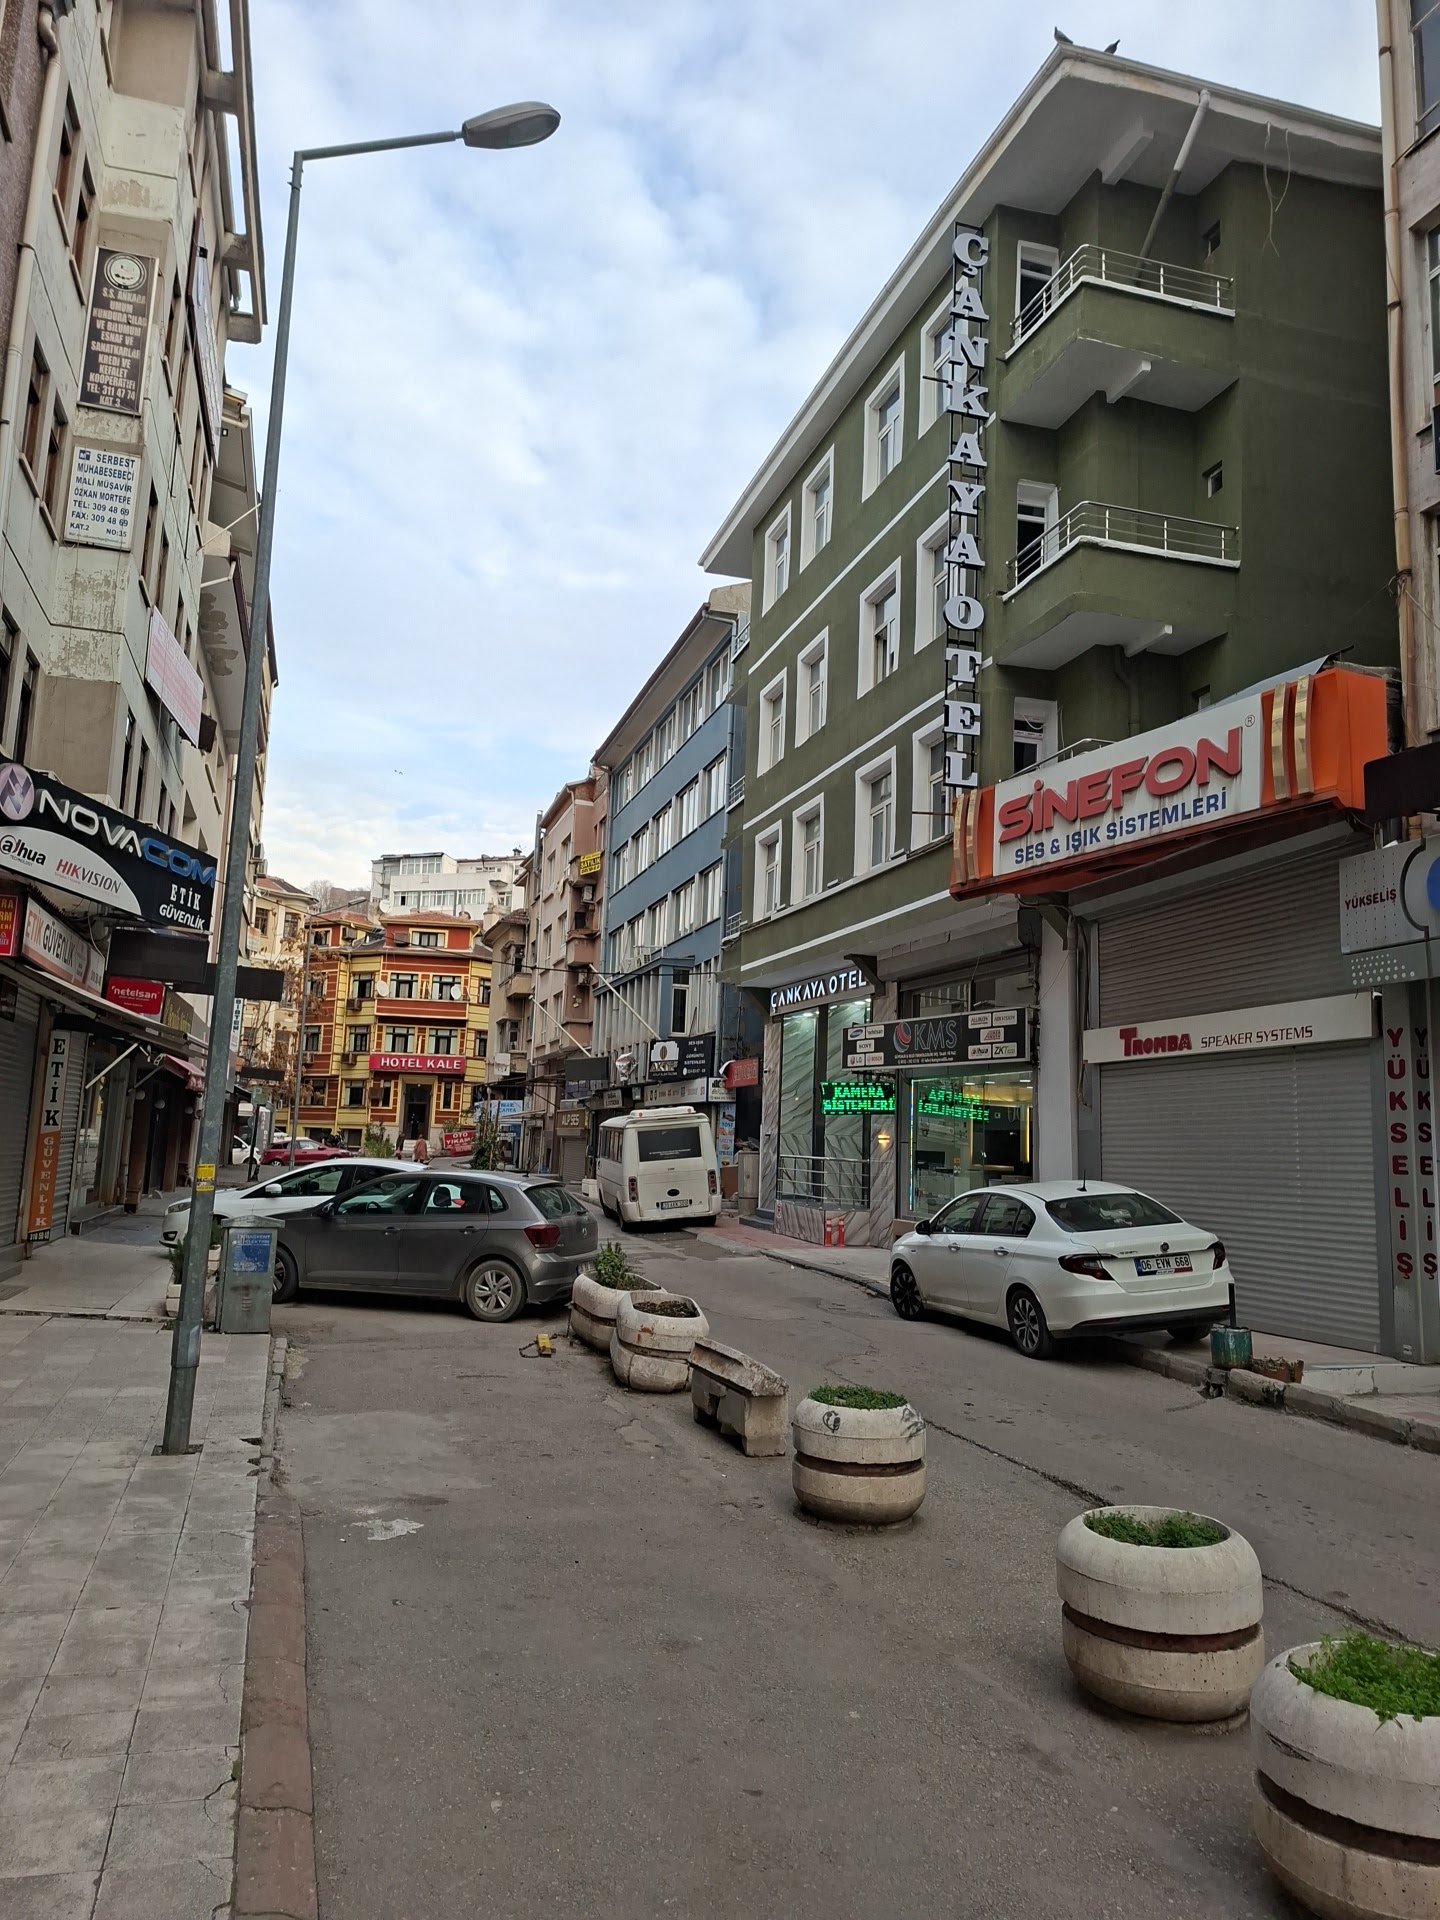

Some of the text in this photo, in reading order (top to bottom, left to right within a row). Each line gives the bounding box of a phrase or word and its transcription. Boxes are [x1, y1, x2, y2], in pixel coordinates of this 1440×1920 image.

[96, 319, 106, 330] VE
[125, 336, 134, 346] VE
[122, 358, 131, 369] VE
[96, 453, 136, 469] SERBEST
[74, 487, 98, 499] ÖZKAN
[71, 510, 89, 520] FAX:
[90, 513, 105, 523] 309
[107, 516, 117, 525] 48
[73, 499, 90, 509] TEL:
[92, 503, 107, 512] 309
[108, 504, 118, 514] 48
[943, 233, 989, 788] ÇANKAYA OTEL
[998, 725, 1243, 844] SİNEFON
[1014, 786, 1227, 865] SES & IŞIK SİSTEMLERİ
[38, 788, 215, 888] NOVACOM
[55, 858, 122, 894] HIKVISION
[170, 883, 202, 911] ETİK
[1344, 888, 1397, 911] YÜKSELİŞ
[159, 904, 206, 930] GÜVENLİK
[770, 969, 867, 1014] ÇANKAYA OTEL
[914, 1019, 958, 1051] KMS
[1201, 1031, 1253, 1049] SPEAKER
[1256, 1025, 1313, 1043] SYSTEMS
[380, 1056, 462, 1070] HOTEL KALE
[44, 1038, 66, 1126] ETİK
[834, 1086, 885, 1099] KAMERA
[823, 1097, 895, 1111] SİSTEMLERİ
[1386, 1027, 1414, 1280] YÜKSELİŞ
[1141, 1260, 1152, 1271] 06
[1175, 1256, 1190, 1267] 668
